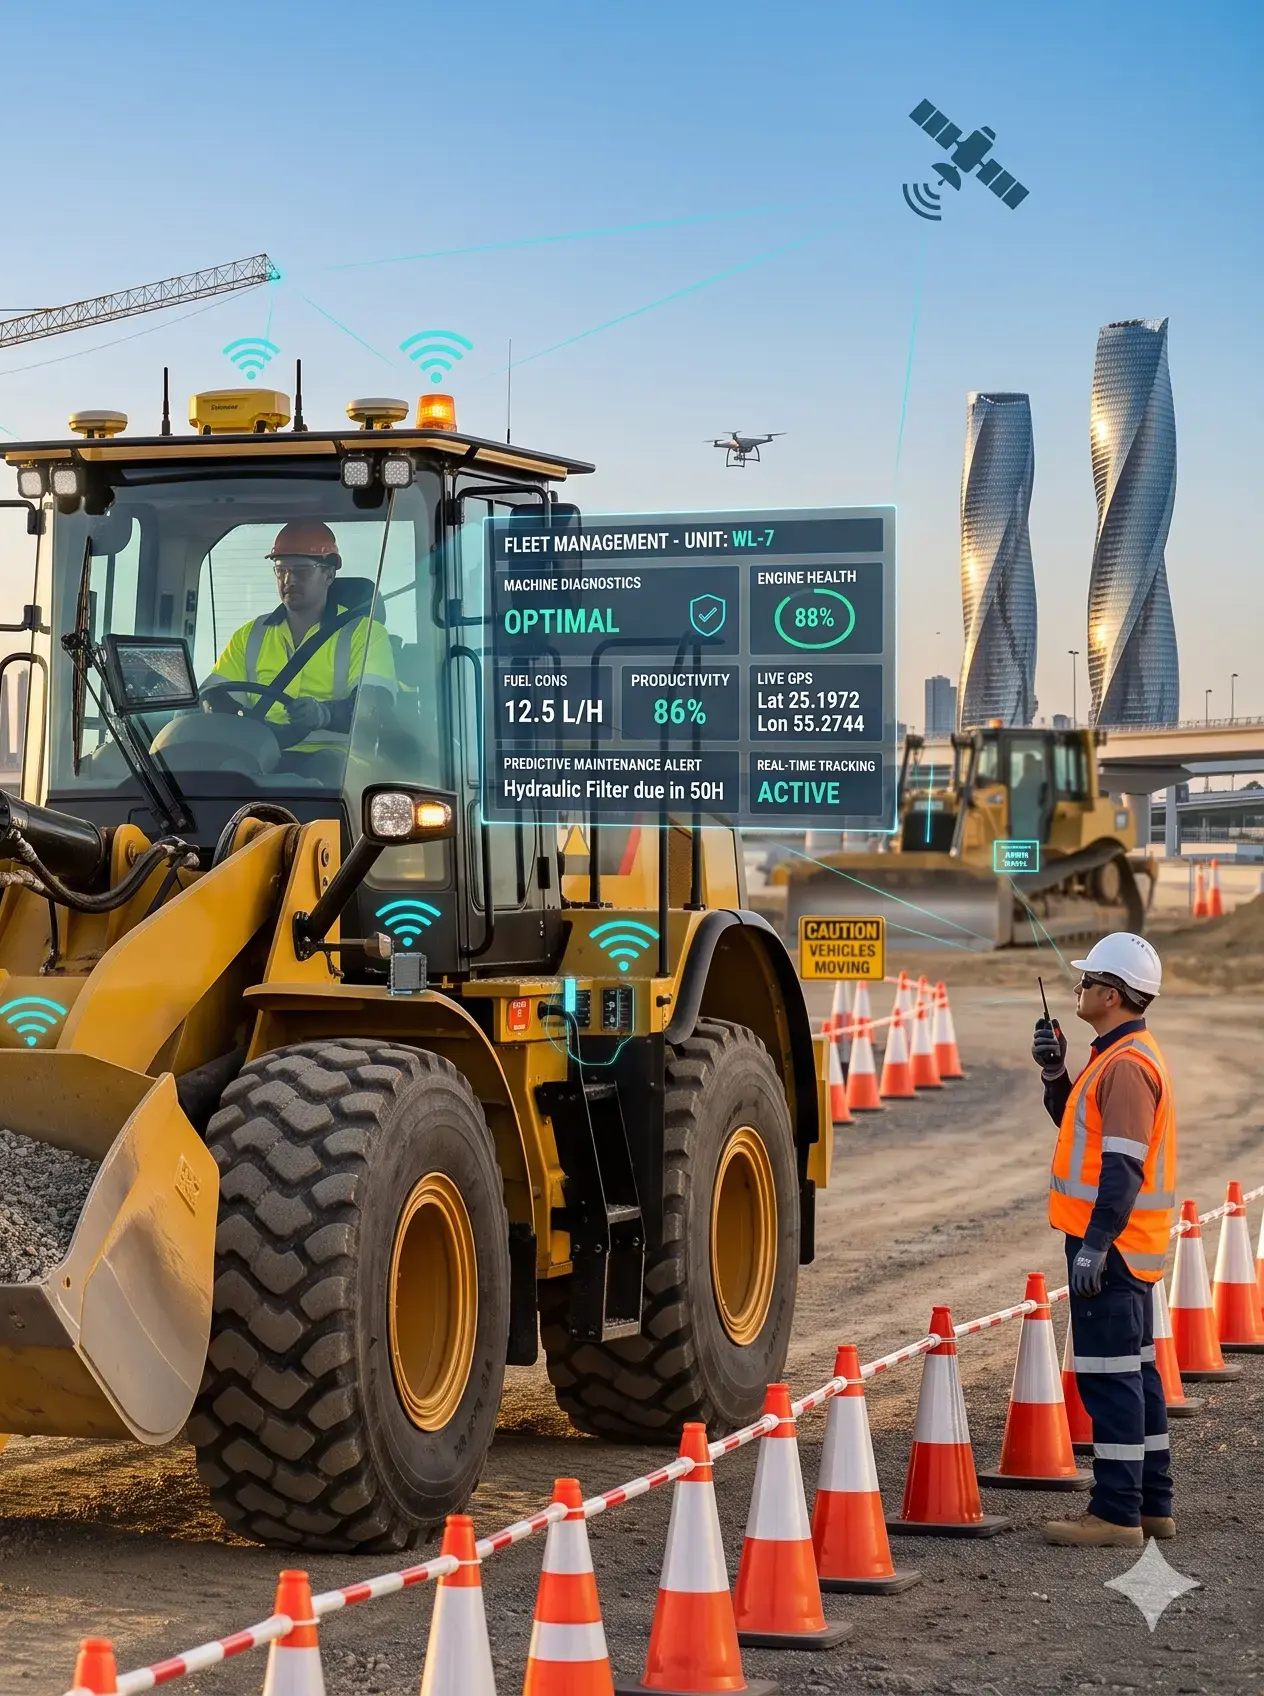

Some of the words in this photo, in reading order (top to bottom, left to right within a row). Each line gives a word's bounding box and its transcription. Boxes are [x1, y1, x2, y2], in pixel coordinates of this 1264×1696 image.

[806, 922, 877, 939] CAUTION
[809, 943, 876, 958] VEHICLES
[814, 960, 870, 974] MOVING
